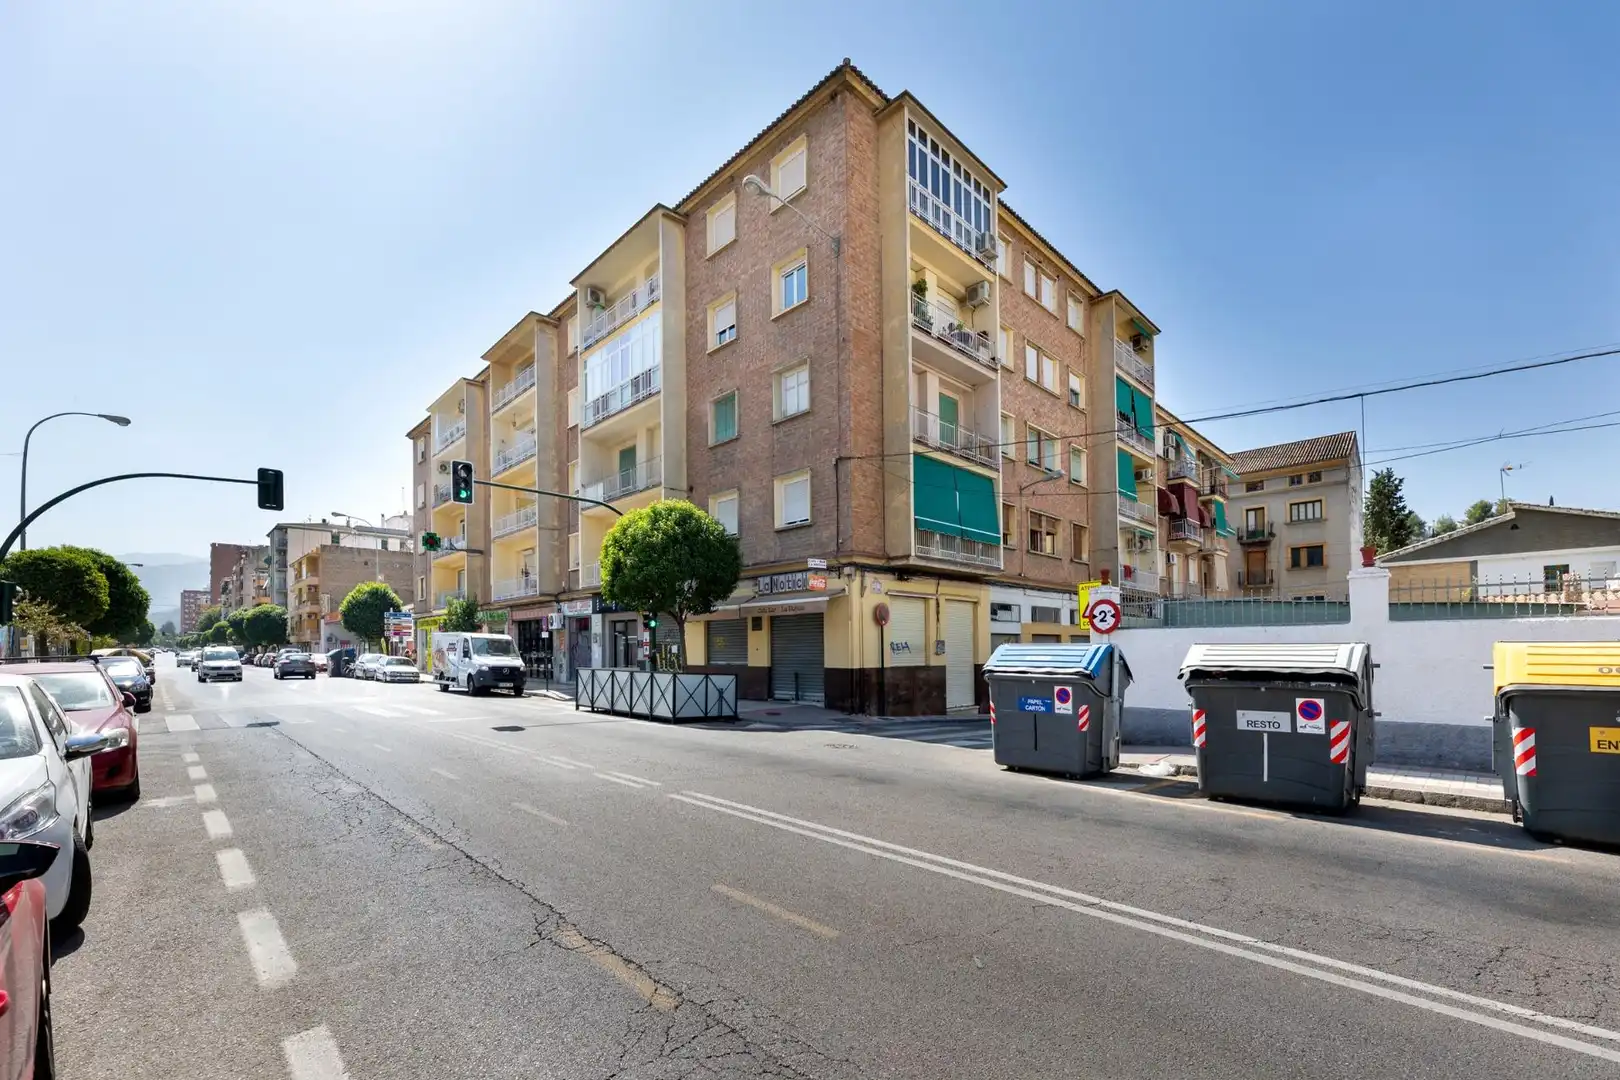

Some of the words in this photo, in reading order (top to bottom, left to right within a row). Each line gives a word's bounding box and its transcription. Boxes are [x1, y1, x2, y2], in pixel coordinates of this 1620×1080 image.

[757, 577, 769, 592] La
[772, 573, 808, 592] Notici
[1246, 719, 1281, 729] RESTO
[1597, 740, 1620, 750] EN
